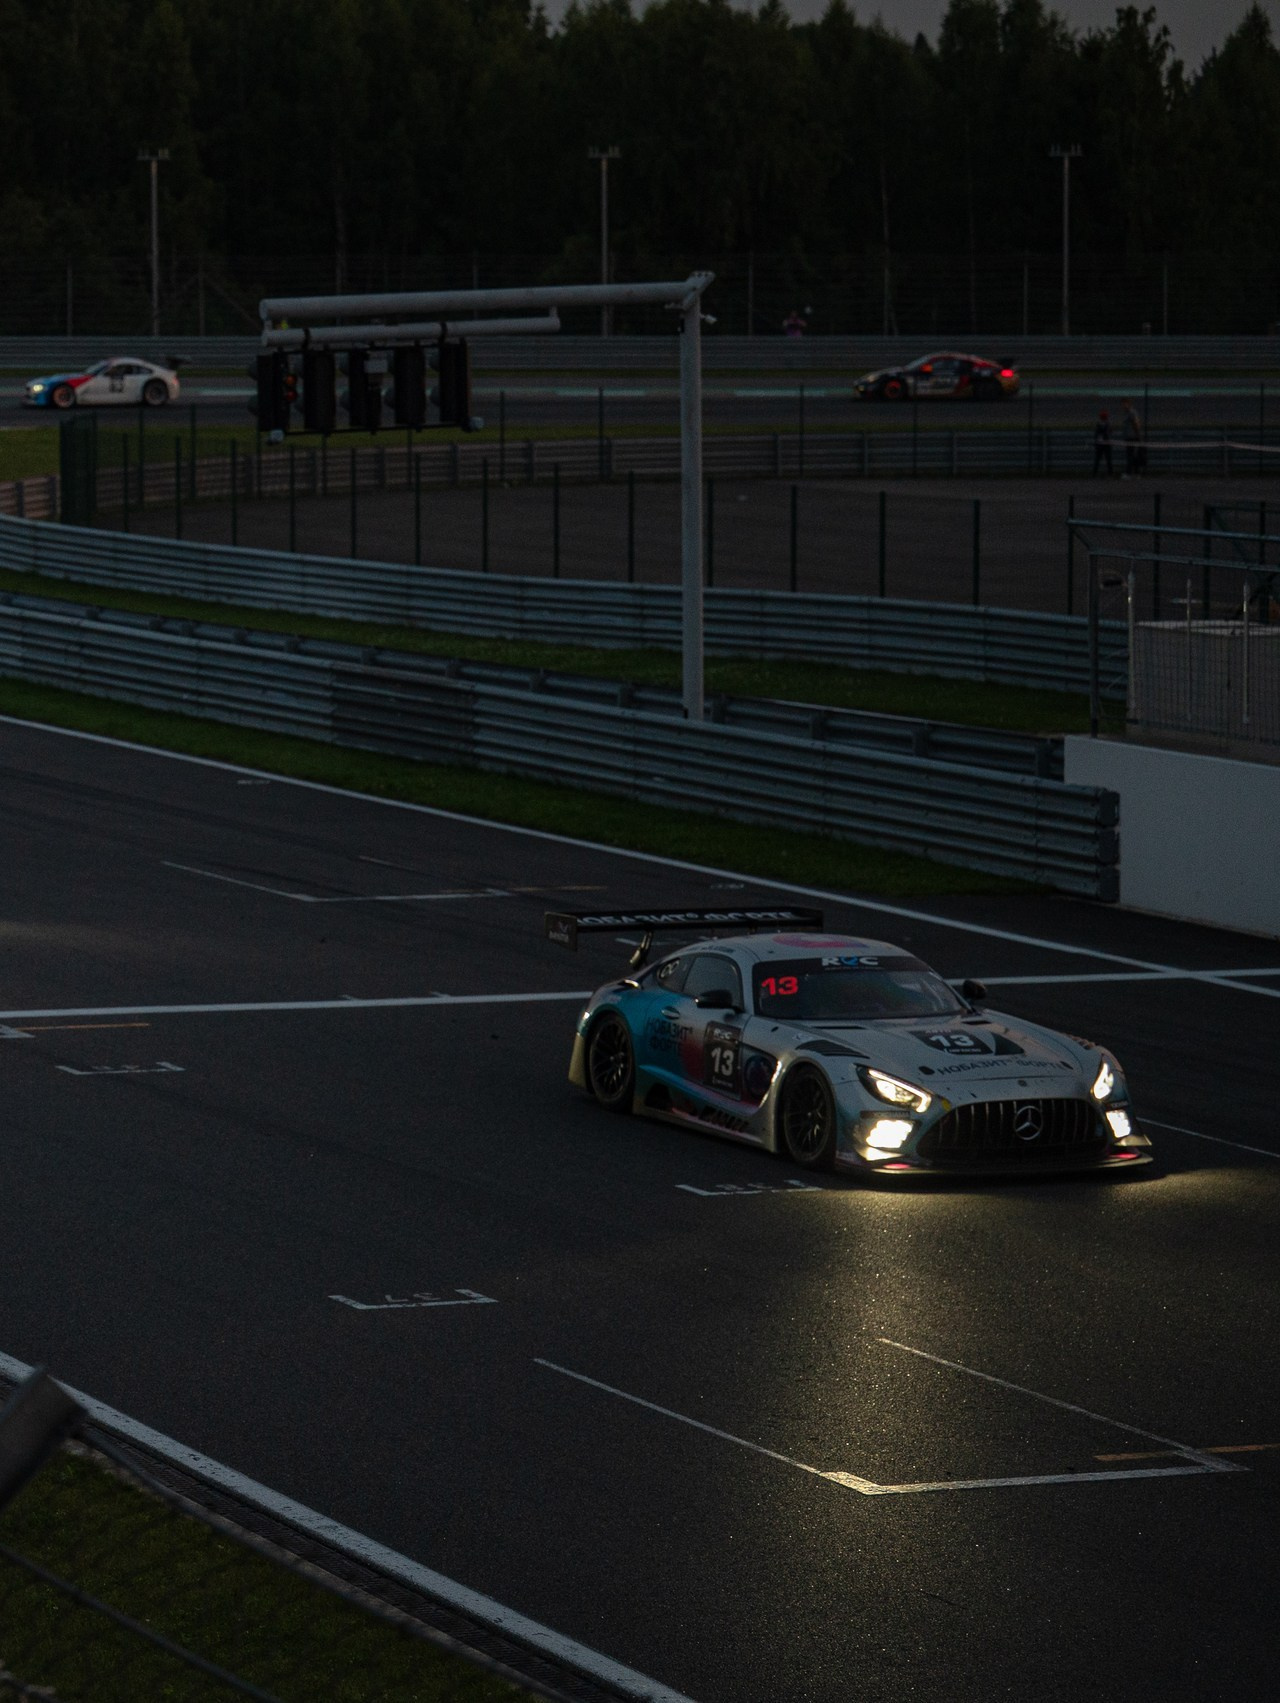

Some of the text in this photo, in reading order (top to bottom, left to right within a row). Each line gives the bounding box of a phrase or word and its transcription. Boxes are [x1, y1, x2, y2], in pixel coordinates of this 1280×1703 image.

[761, 975, 799, 997] 13
[929, 1034, 975, 1048] 13
[710, 1047, 734, 1077] 13
